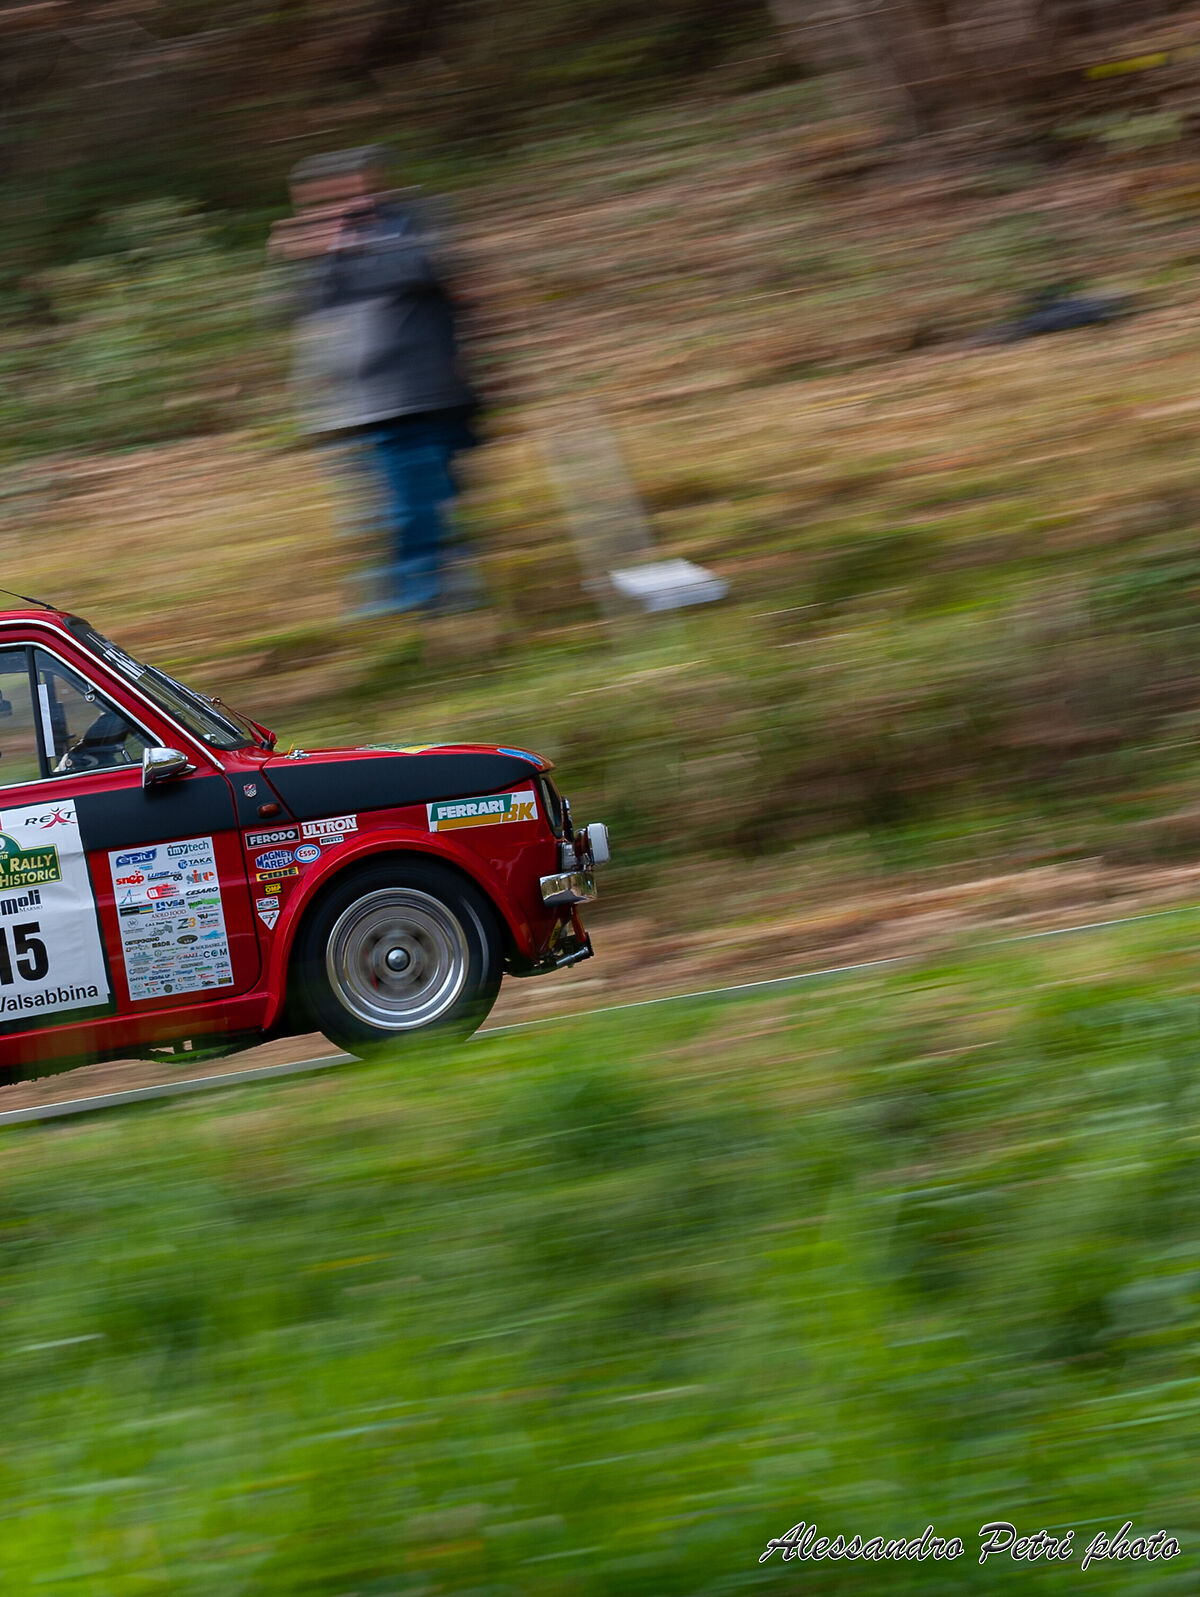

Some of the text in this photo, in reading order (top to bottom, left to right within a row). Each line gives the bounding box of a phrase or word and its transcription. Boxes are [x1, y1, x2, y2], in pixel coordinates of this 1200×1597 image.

[437, 800, 535, 823] FERRARI BK
[302, 817, 357, 837] ULTRON
[249, 830, 296, 845] FERODO
[10, 854, 54, 872] RALLY
[0, 868, 57, 888] HISTORIC
